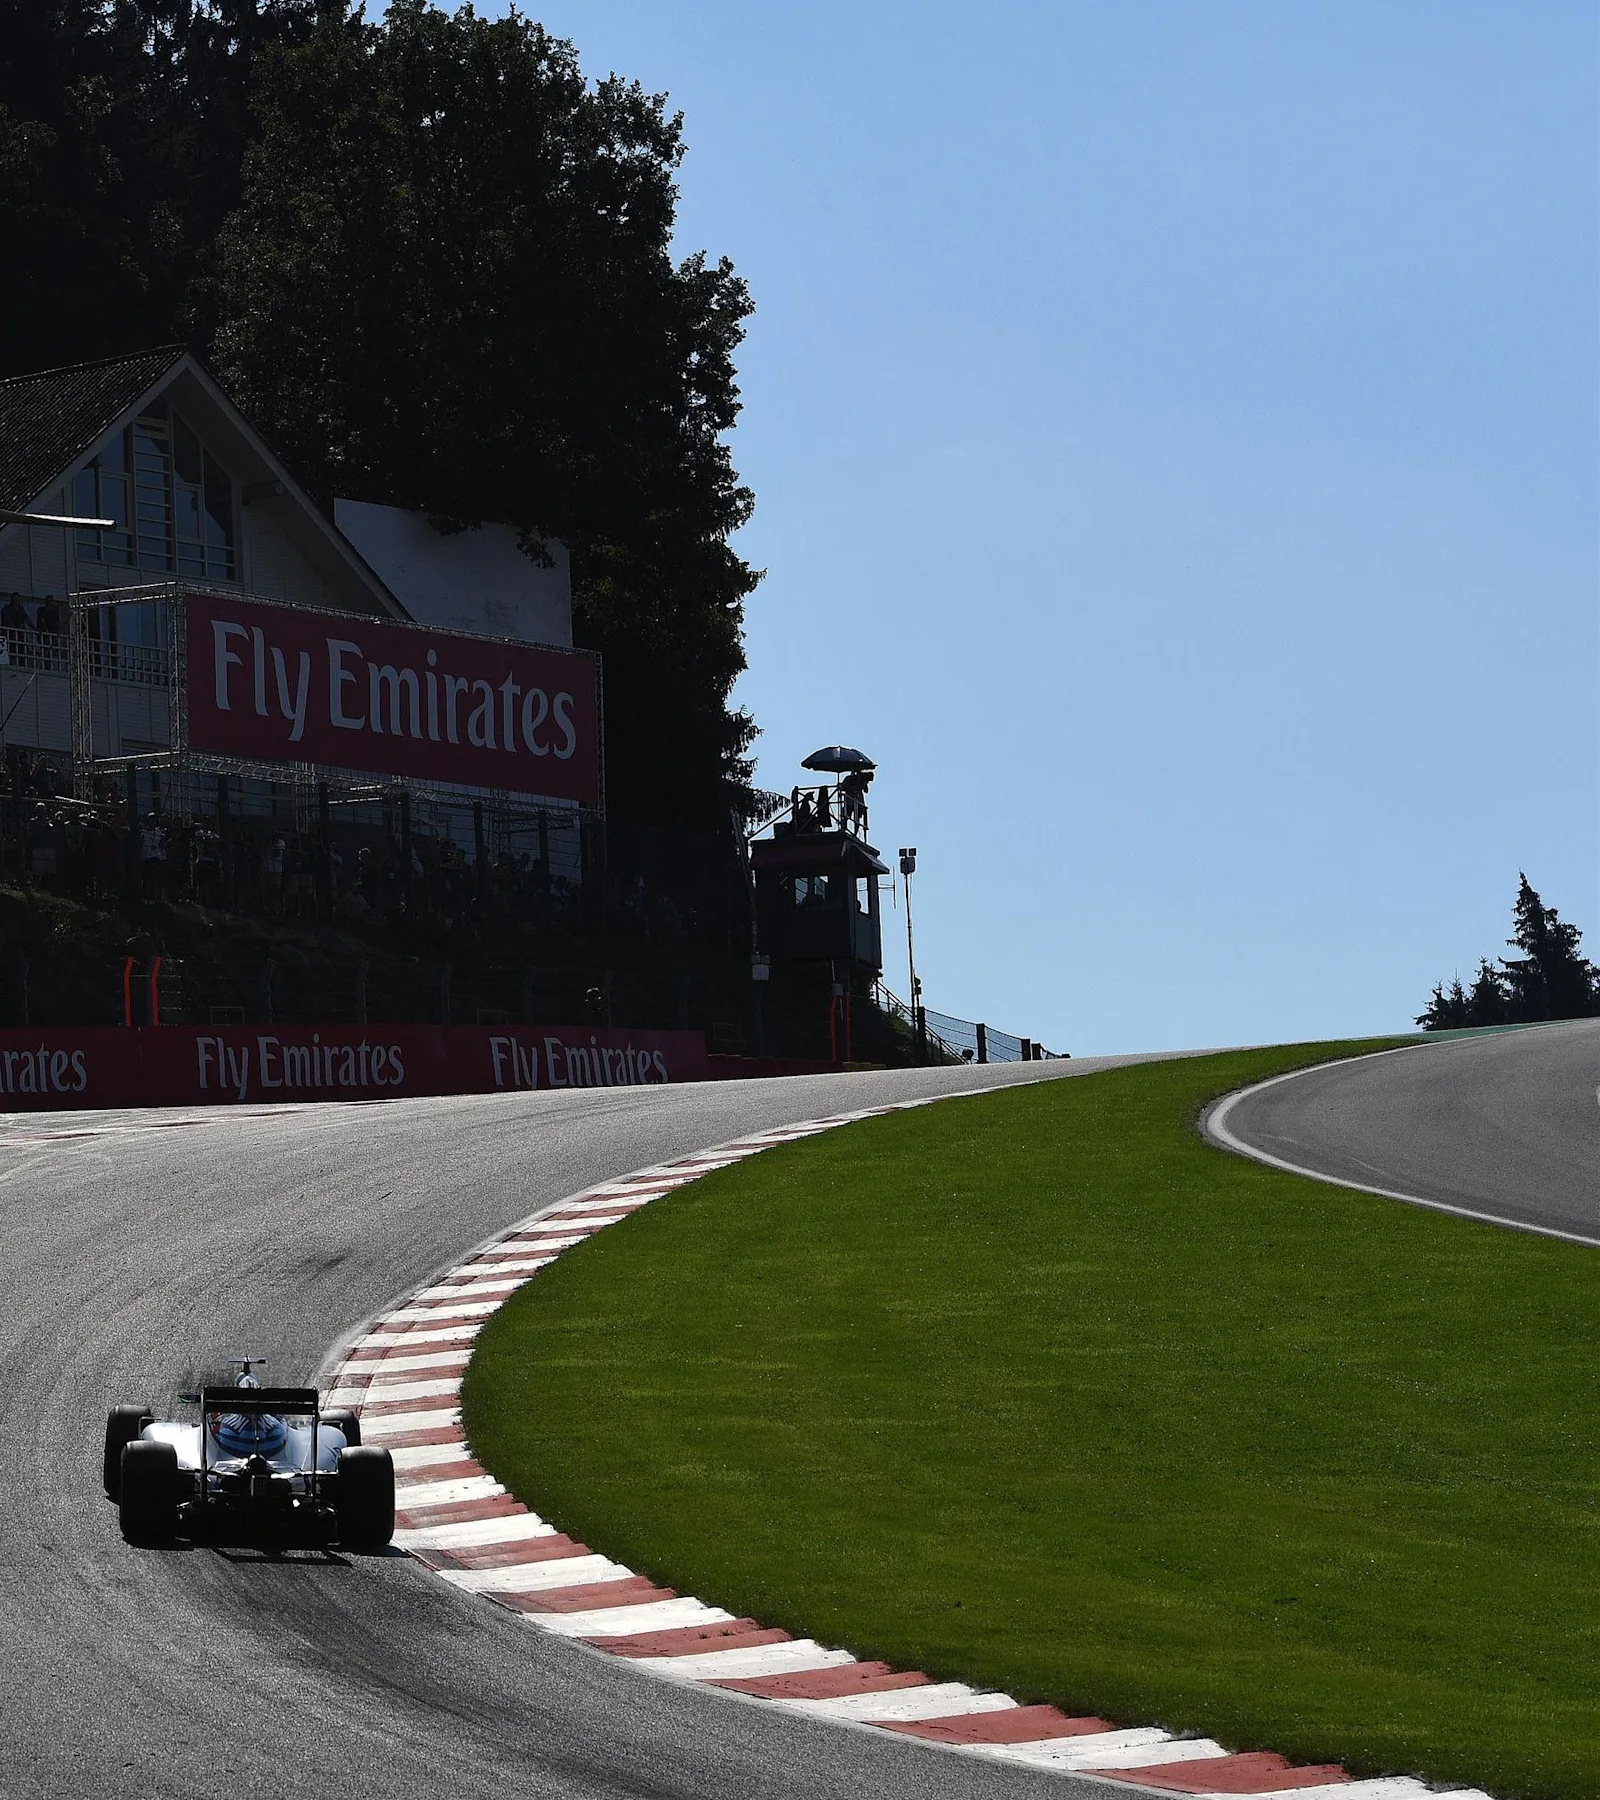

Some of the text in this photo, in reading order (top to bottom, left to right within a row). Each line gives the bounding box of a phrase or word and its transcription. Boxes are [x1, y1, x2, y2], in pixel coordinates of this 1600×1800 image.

[211, 620, 576, 759] Fly Emirates
[196, 1034, 404, 1099] Fly Emirates
[489, 1036, 668, 1089] Fly Emirates
